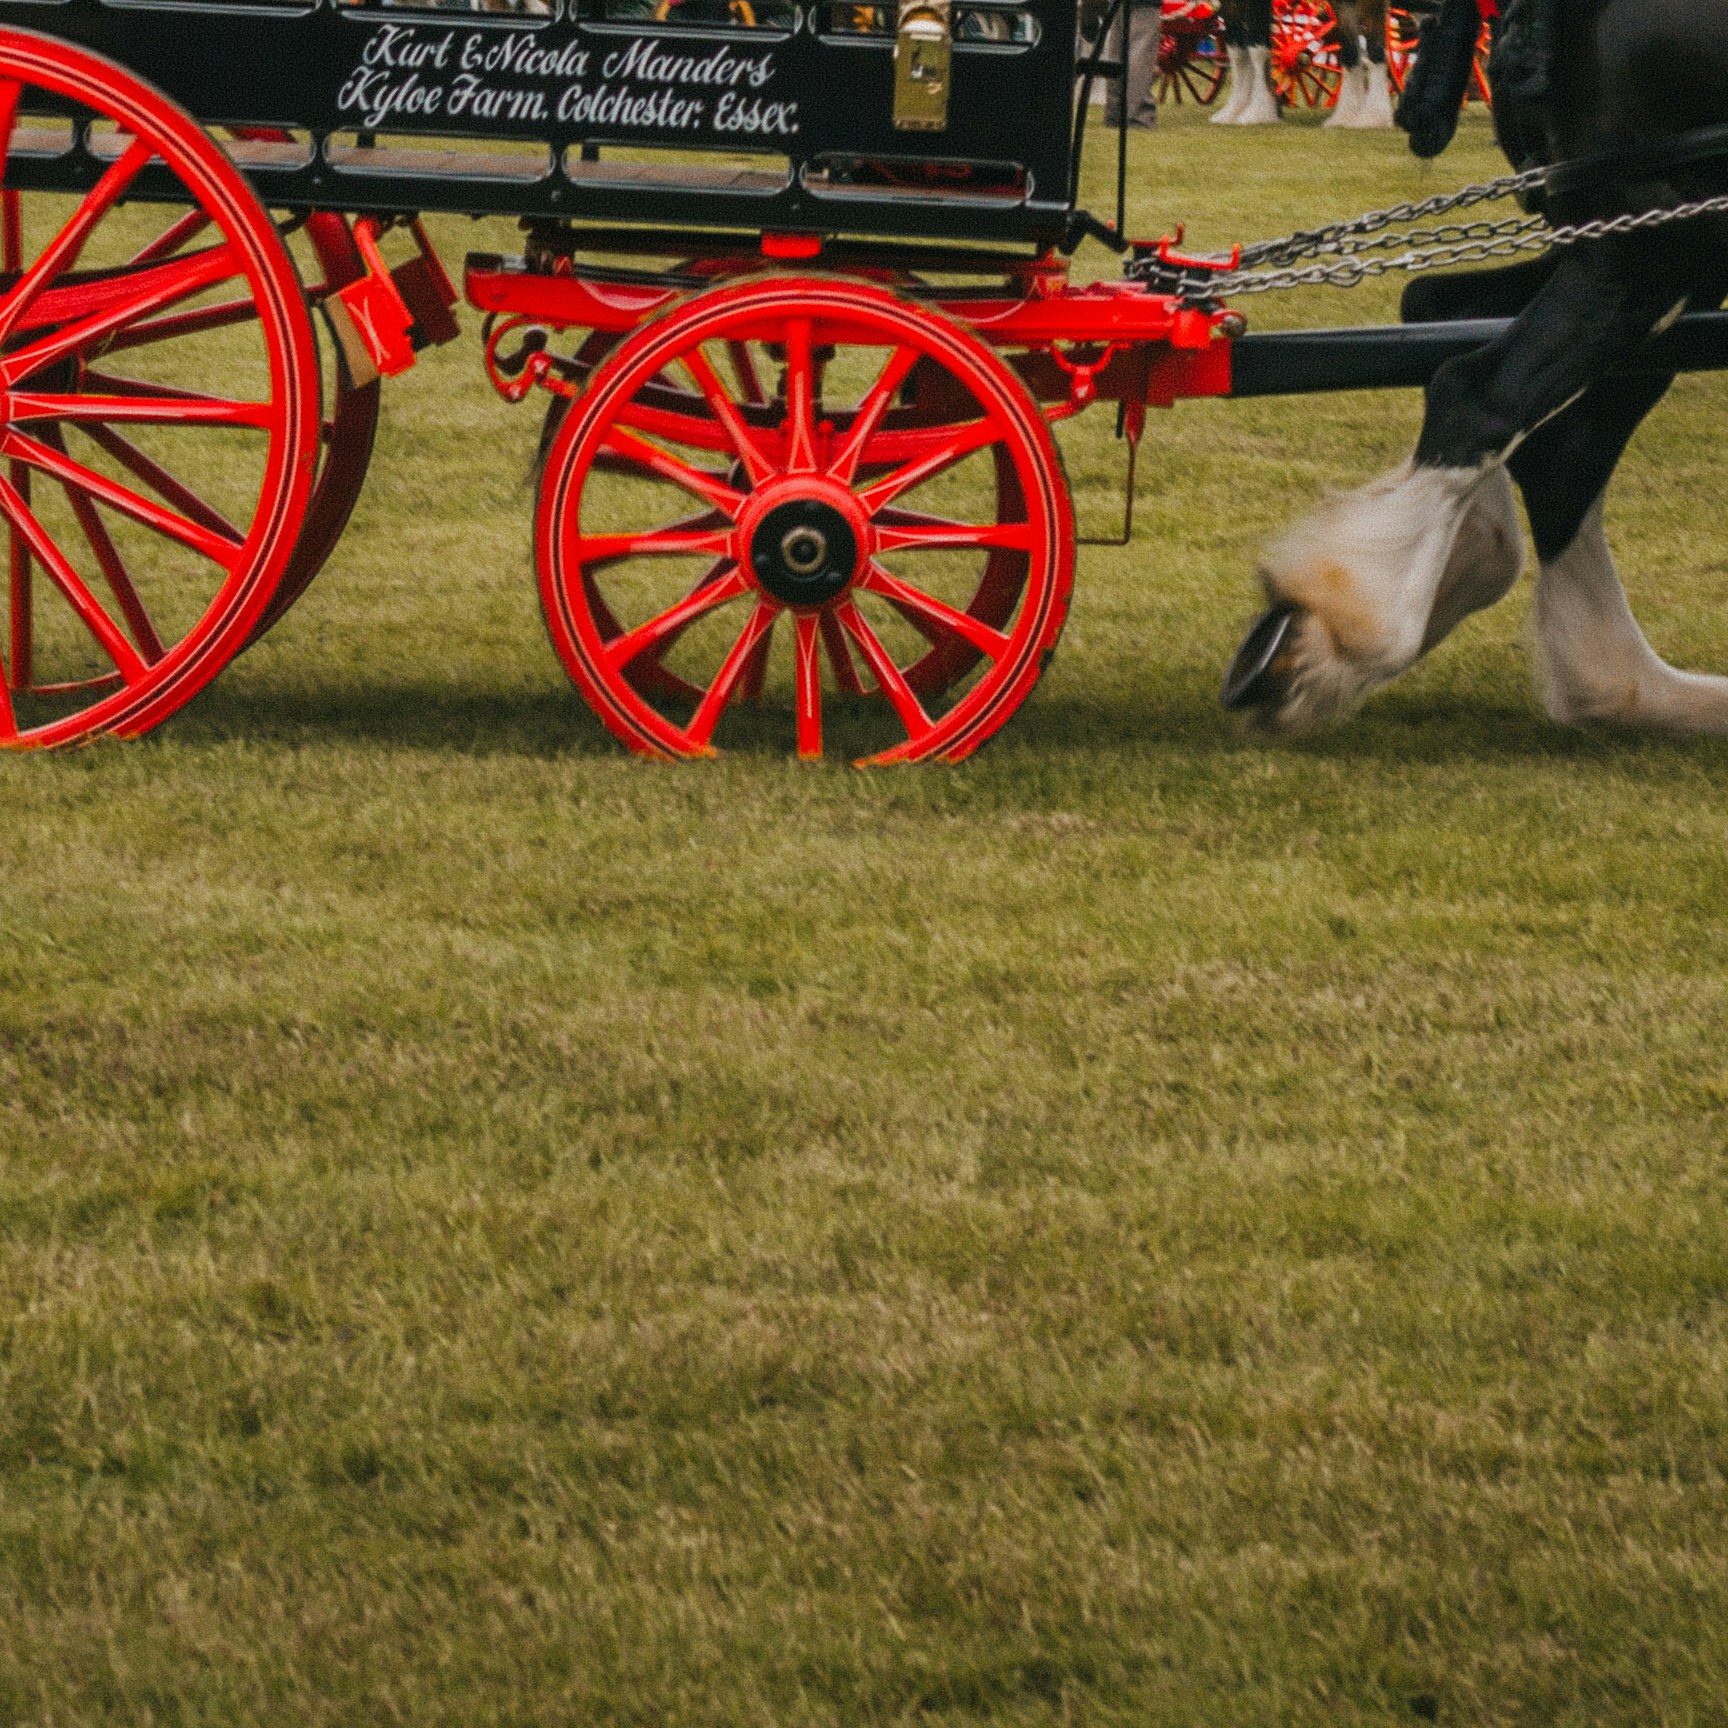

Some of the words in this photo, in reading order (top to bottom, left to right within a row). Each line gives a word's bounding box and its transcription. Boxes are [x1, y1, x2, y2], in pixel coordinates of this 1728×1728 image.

[363, 23, 455, 69] Kurt
[484, 33, 591, 77] Nicola
[603, 38, 775, 87] Manders
[337, 65, 443, 129] Kyloe
